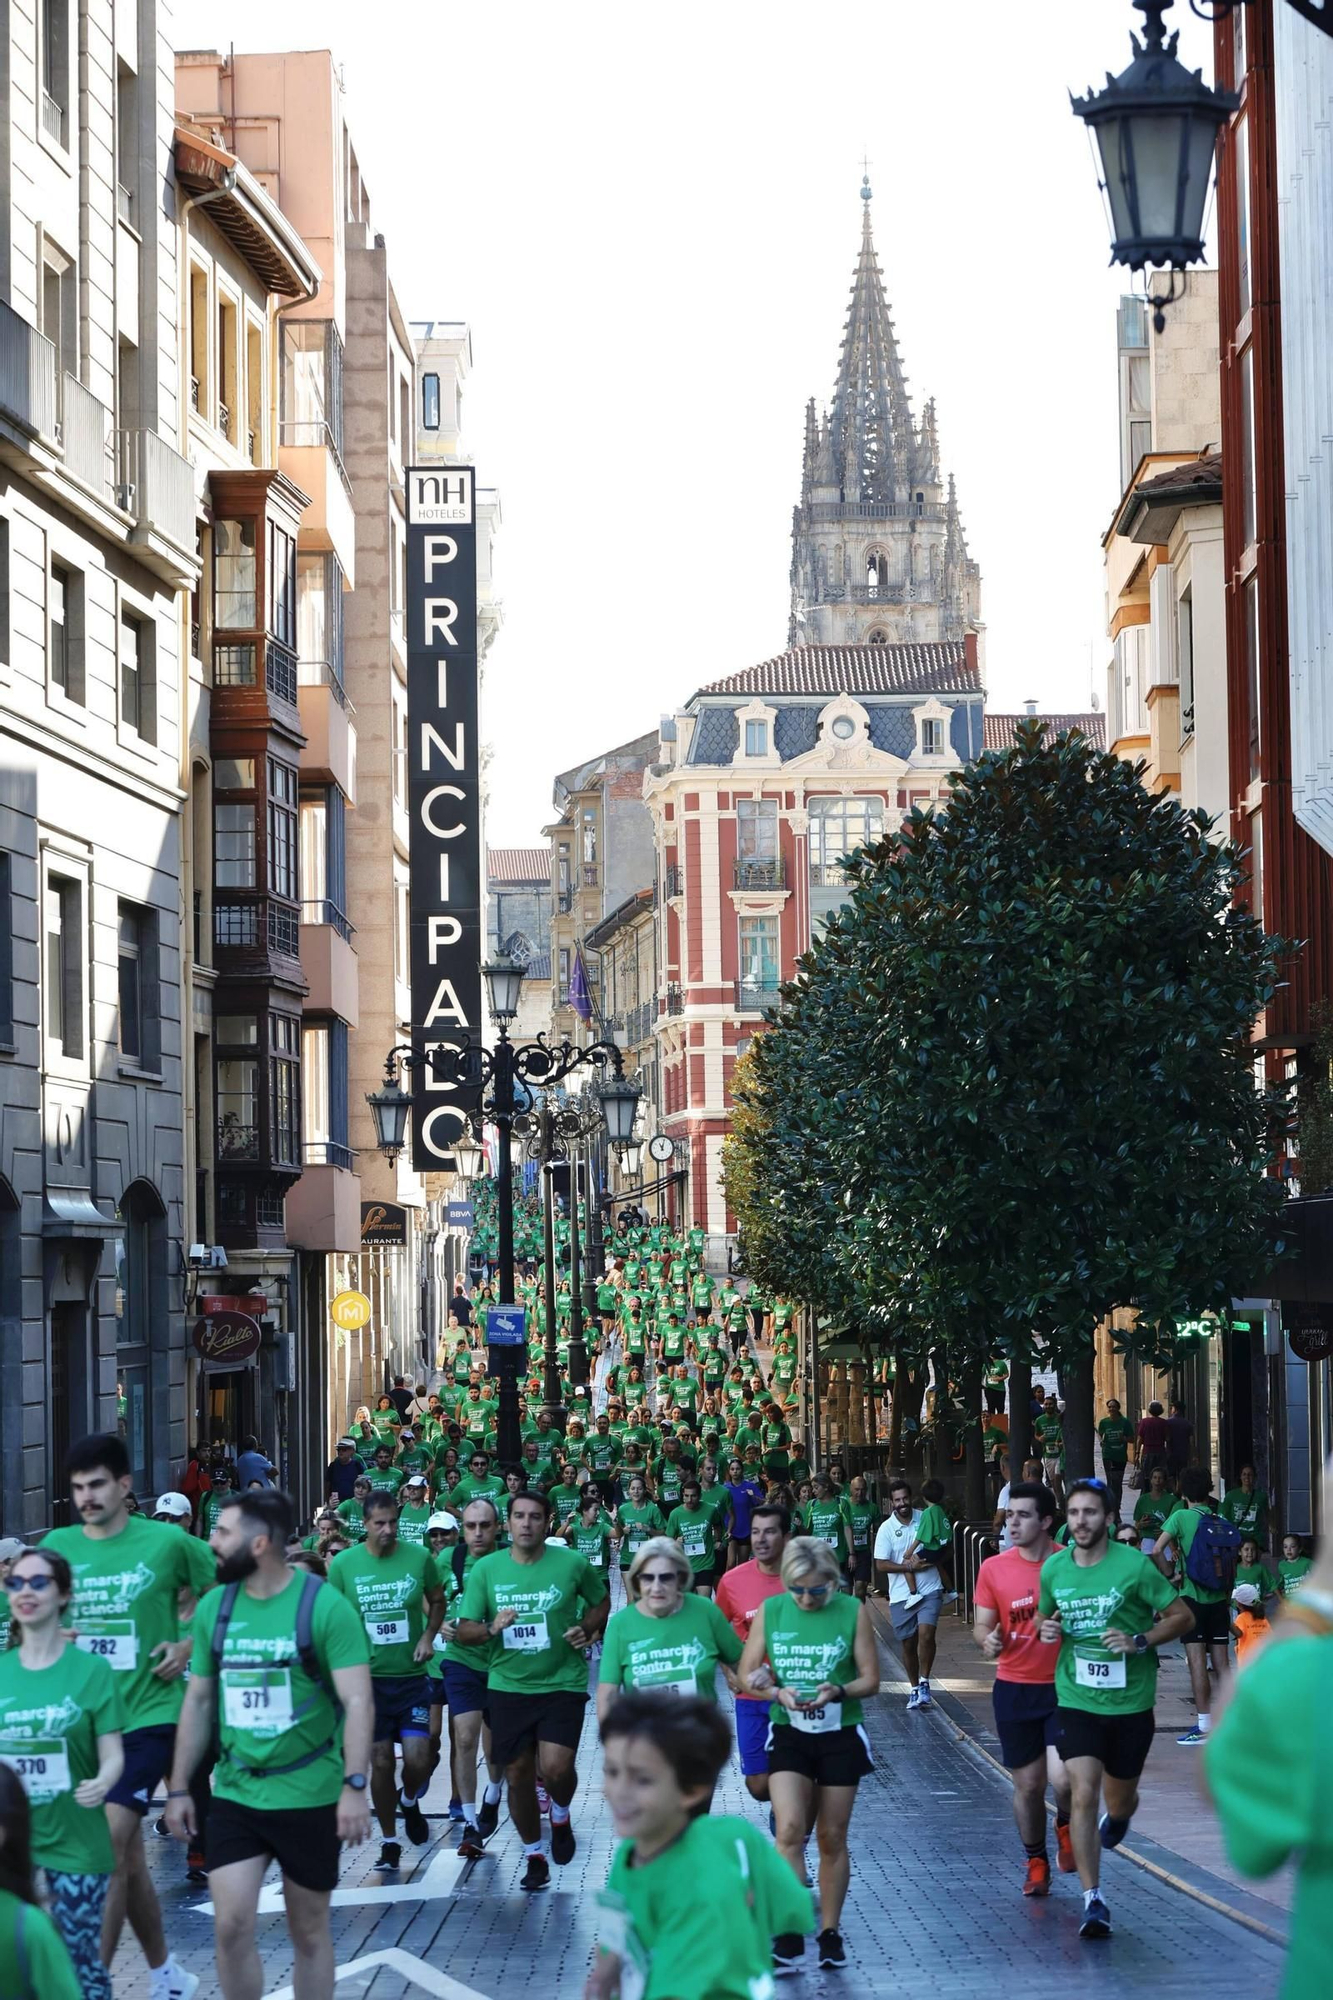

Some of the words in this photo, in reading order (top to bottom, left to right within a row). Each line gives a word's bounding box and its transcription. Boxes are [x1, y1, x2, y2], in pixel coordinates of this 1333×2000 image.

[418, 509, 466, 519] HOTELES
[449, 1210, 471, 1218] BBVA
[201, 1324, 254, 1353] Rialto
[356, 1584, 370, 1595] En
[358, 1591, 390, 1603] contra
[495, 1593, 509, 1603] En
[360, 1603, 369, 1612] el
[370, 1600, 404, 1611] cáncer
[376, 1622, 397, 1636] 508
[512, 1625, 536, 1639] 1014
[90, 1638, 117, 1655] 282
[772, 1642, 788, 1655] En
[631, 1651, 647, 1665] En
[774, 1656, 812, 1667] contra
[631, 1660, 673, 1676] contra
[785, 1668, 830, 1680] cáncer
[1087, 1662, 1110, 1678] 973
[801, 1707, 825, 1720] 185
[15, 1757, 47, 1775] 370
